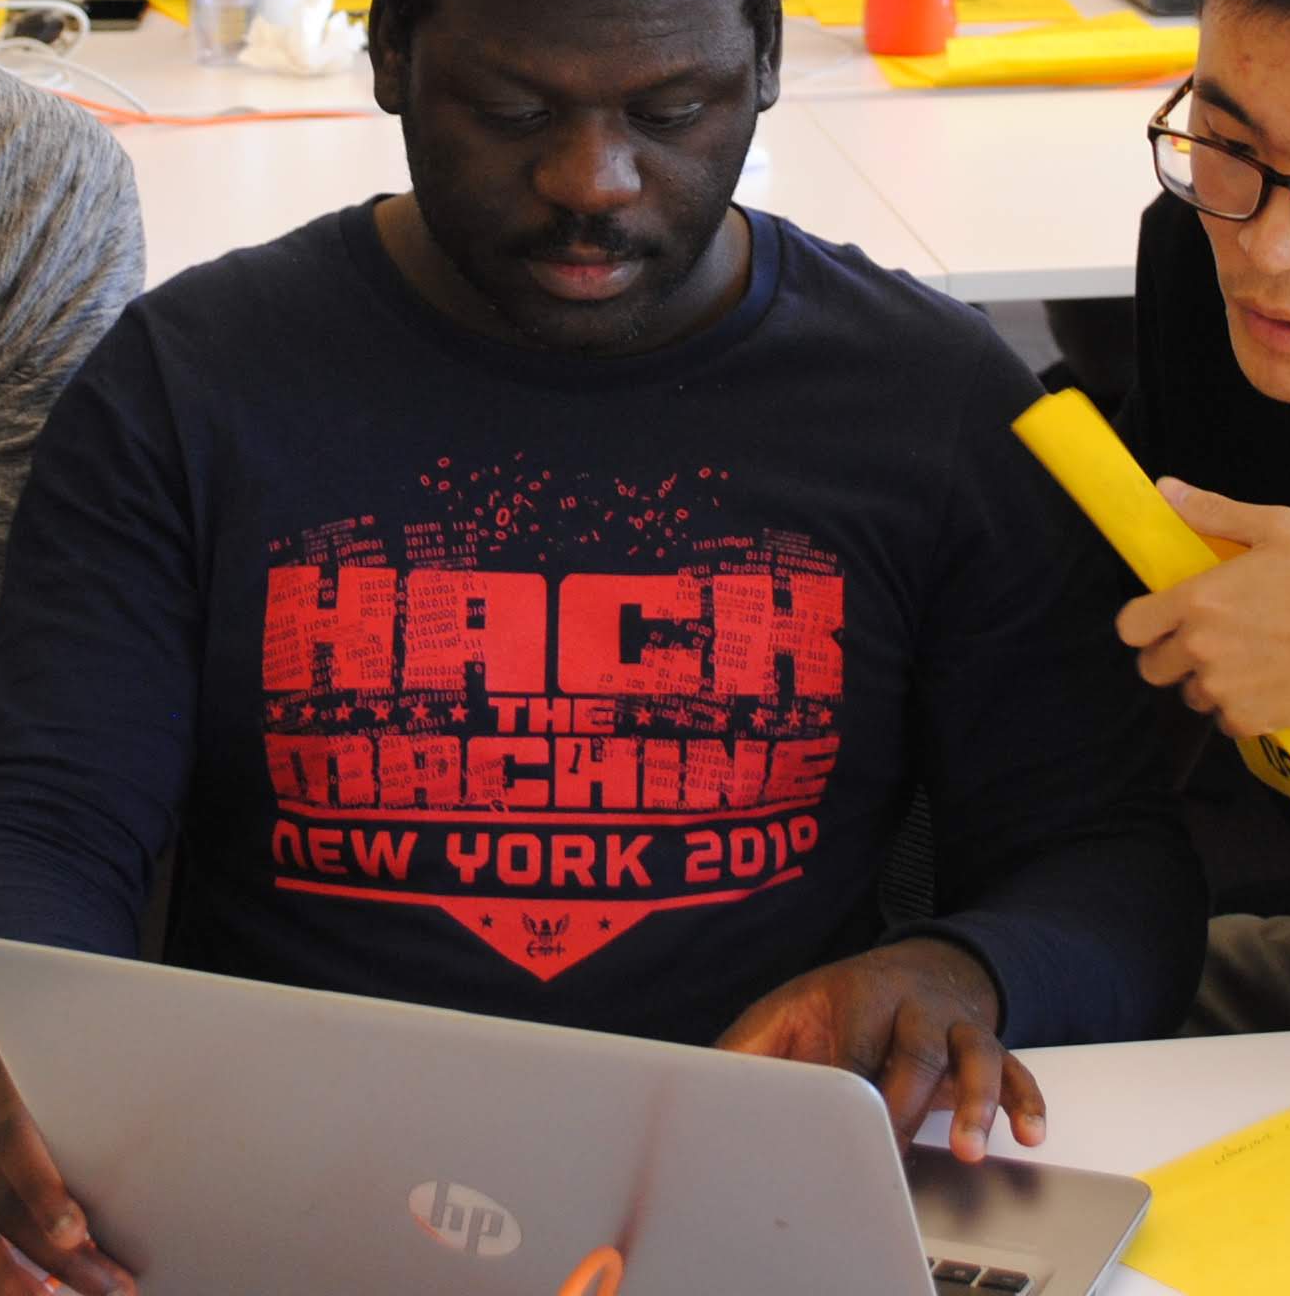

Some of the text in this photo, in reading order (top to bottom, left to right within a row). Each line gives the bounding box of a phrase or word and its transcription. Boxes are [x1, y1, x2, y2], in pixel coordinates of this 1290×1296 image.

[262, 565, 845, 697] HACK
[487, 697, 616, 735] THE
[262, 732, 842, 810] MACHINE
[271, 817, 419, 880] NEW
[445, 830, 653, 888] YORK
[430, 1180, 505, 1256] hp
